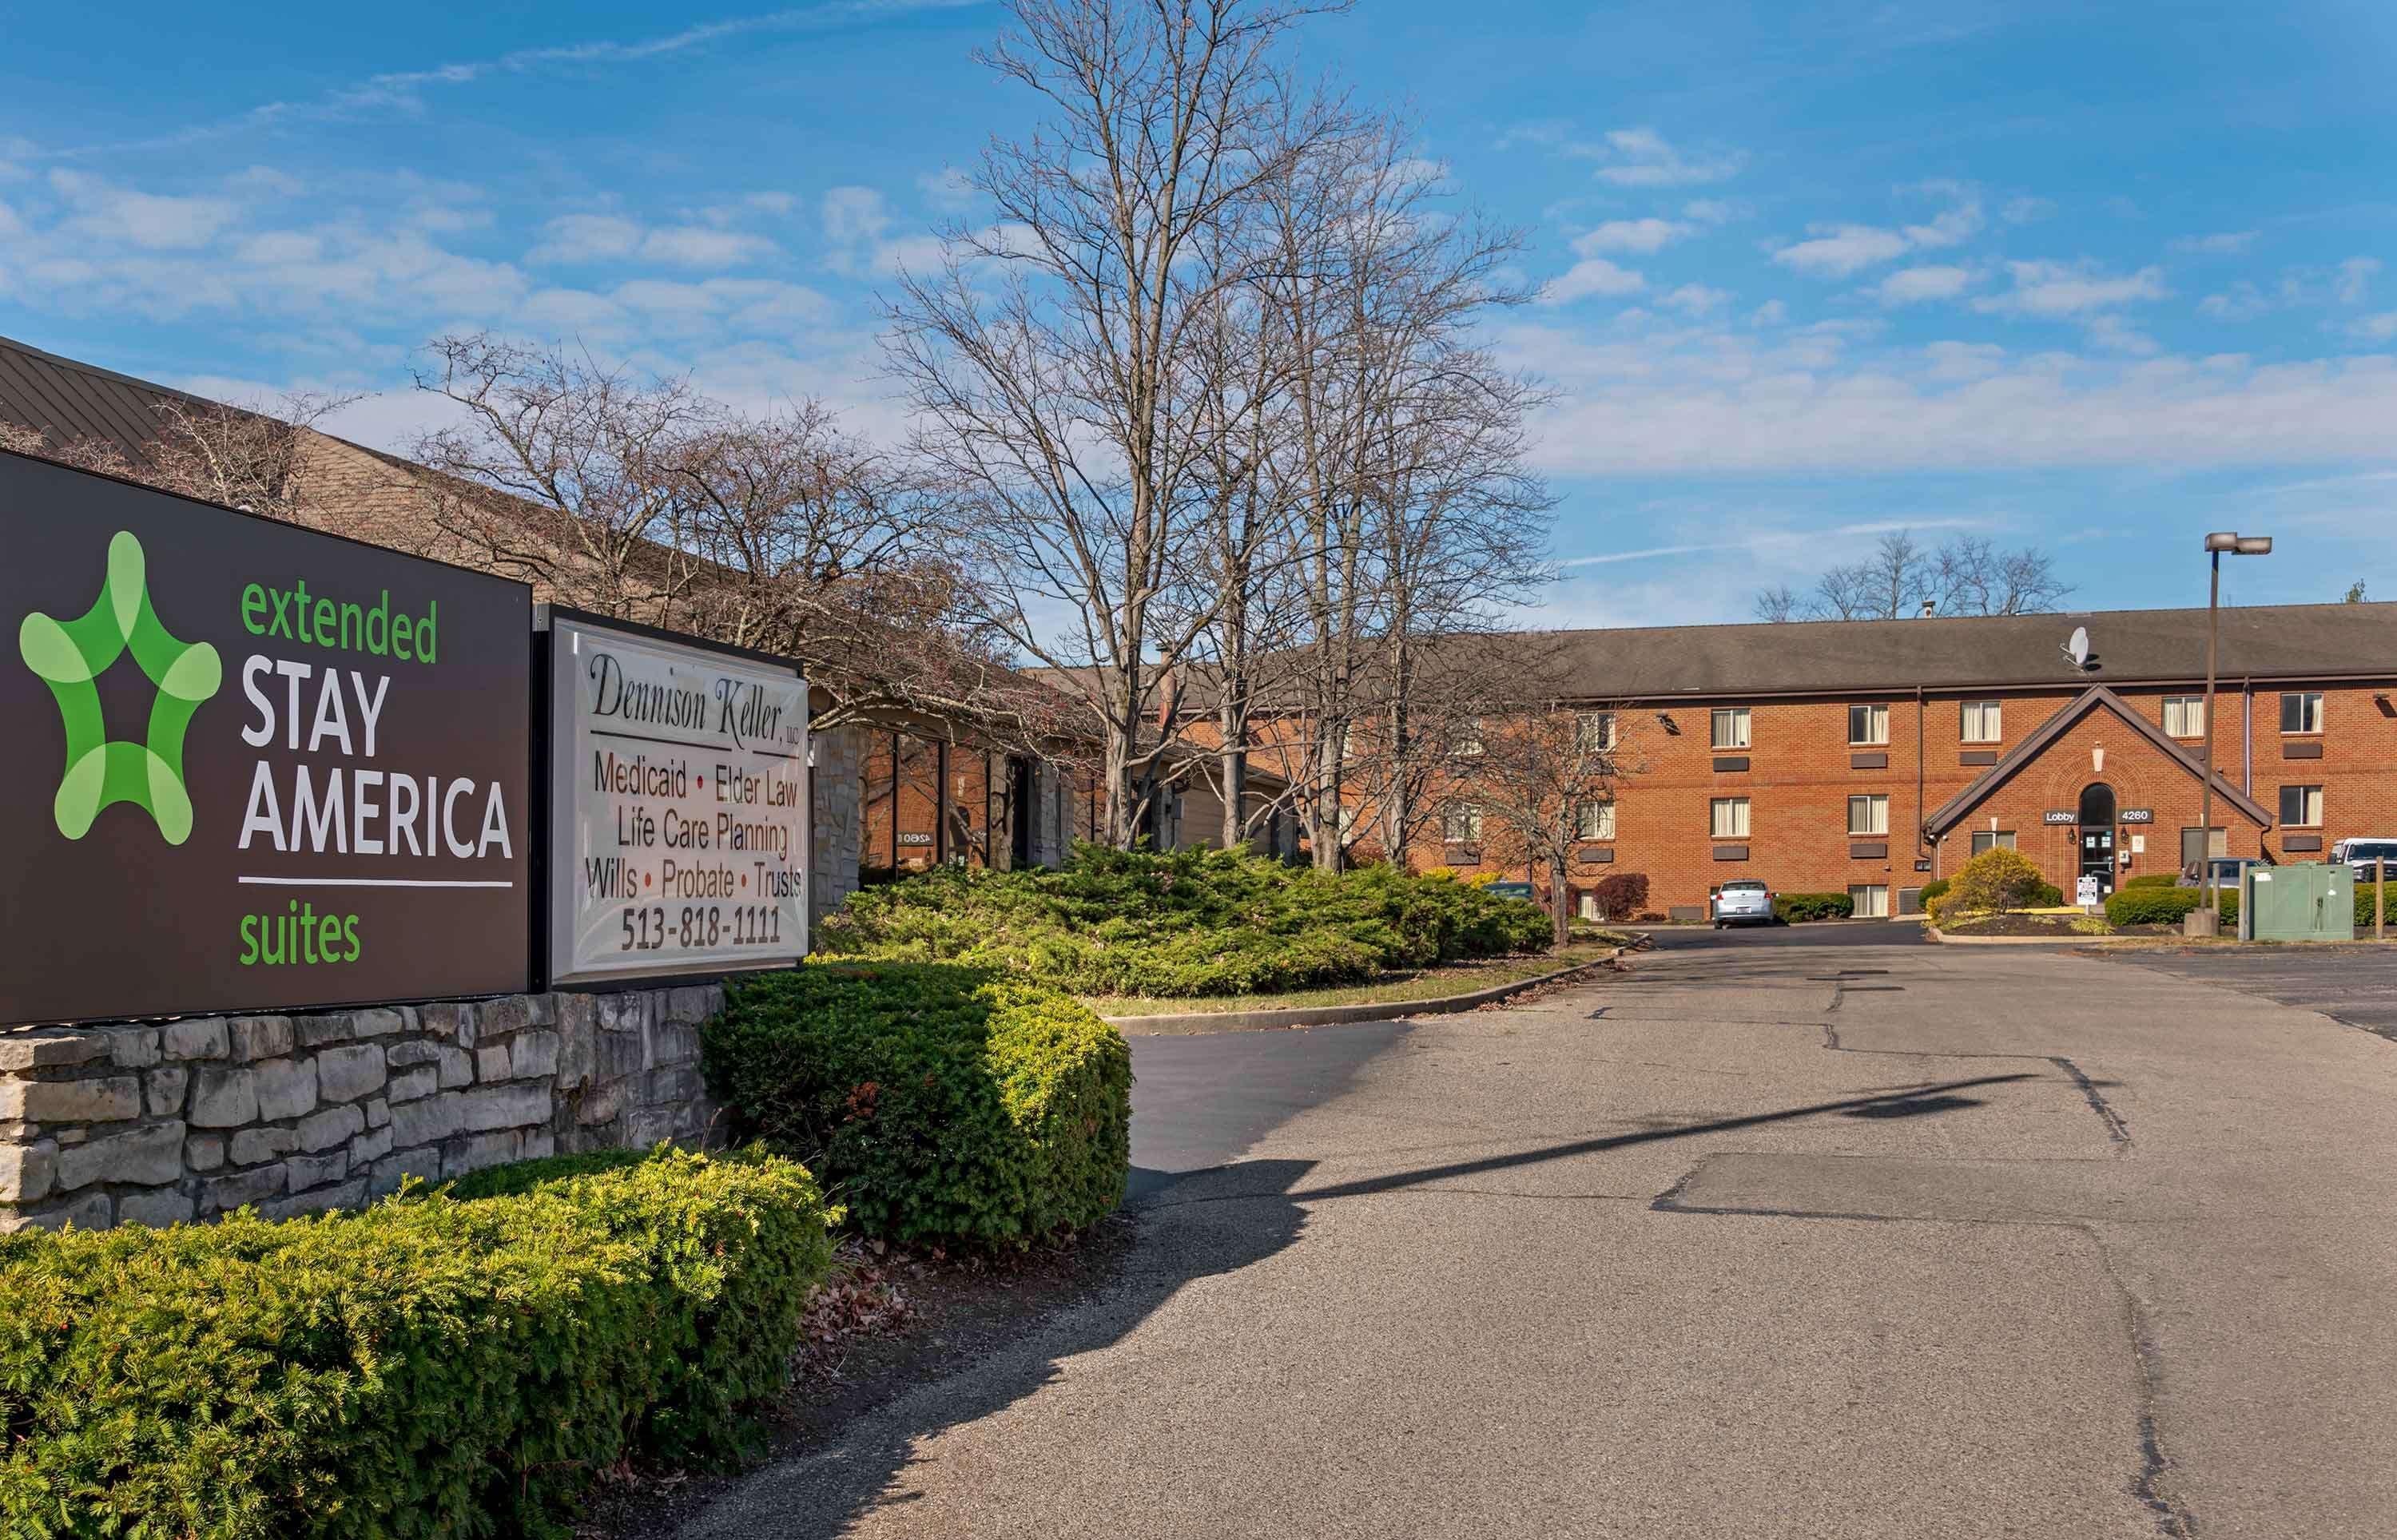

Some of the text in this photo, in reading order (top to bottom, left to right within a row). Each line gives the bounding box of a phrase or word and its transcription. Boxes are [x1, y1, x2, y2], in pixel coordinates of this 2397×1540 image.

[242, 580, 436, 664] extended
[241, 654, 390, 756] STAY
[590, 653, 706, 730] Dennison
[715, 678, 782, 749] Keller,
[594, 751, 797, 808] Medicaid Elder Law
[238, 760, 513, 859] AMERICA
[618, 805, 788, 861] Life Care Planning
[2046, 812, 2074, 822] Lobby
[2122, 811, 2148, 820] 4260
[586, 857, 801, 899] Wills Probate Trusts
[240, 899, 360, 965] suites
[622, 905, 780, 951] 513-818-1111
